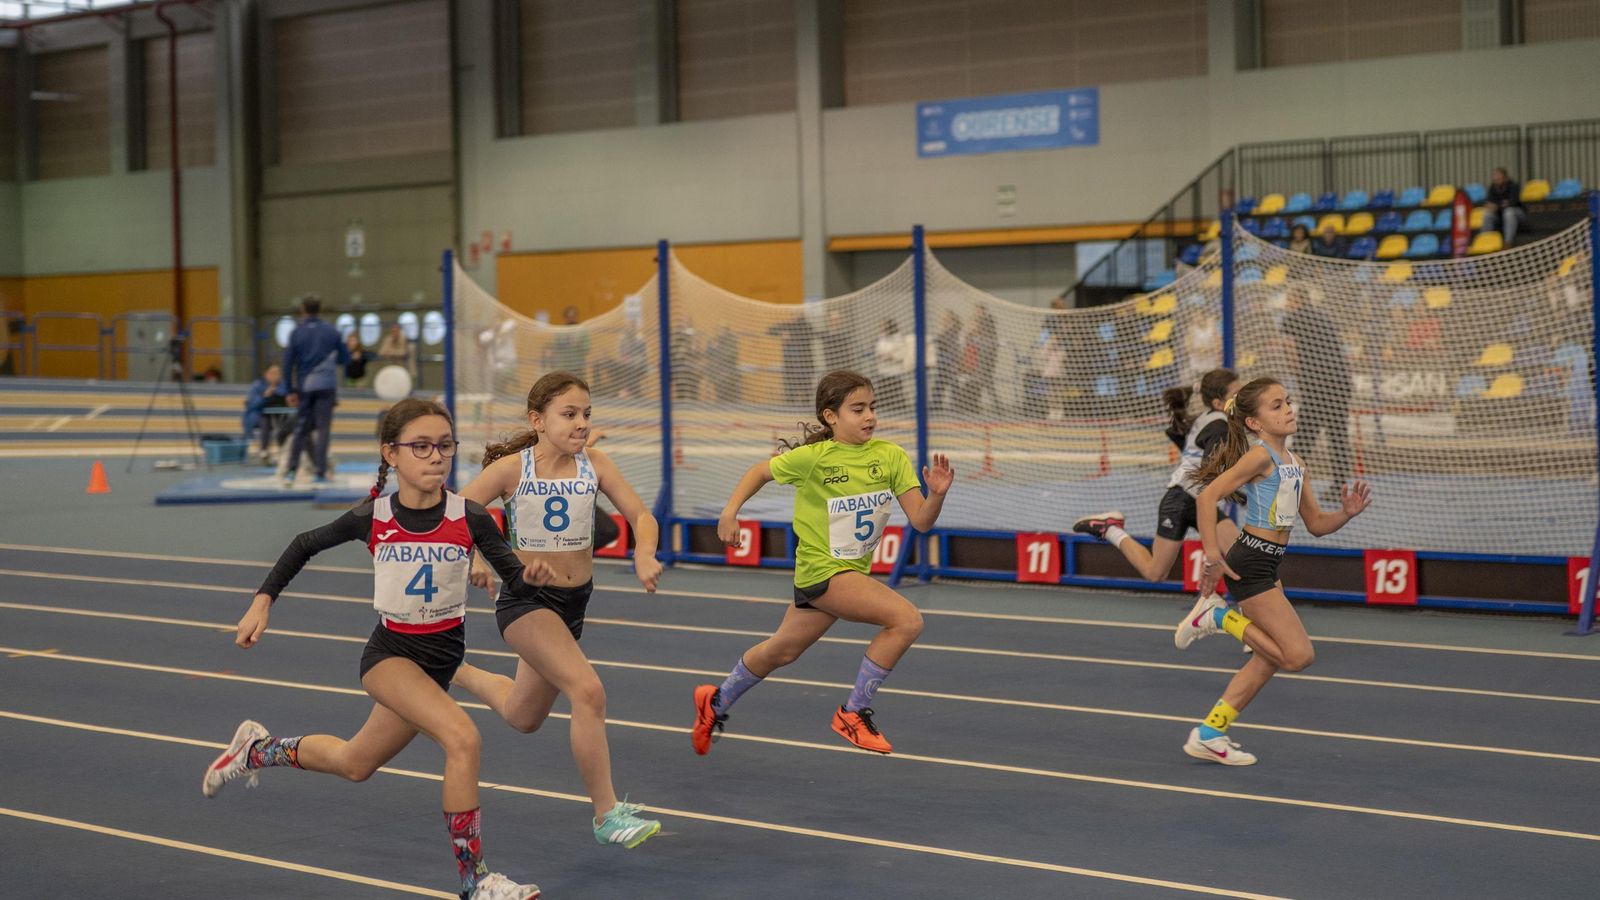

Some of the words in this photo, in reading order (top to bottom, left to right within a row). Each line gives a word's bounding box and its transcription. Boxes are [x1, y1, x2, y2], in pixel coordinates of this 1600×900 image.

[823, 475, 849, 485] PRO
[1294, 479, 1300, 507] 1
[543, 496, 570, 532] 8
[854, 509, 874, 541] 5
[734, 528, 752, 557] 9
[1026, 541, 1051, 573] 11
[1242, 535, 1274, 555] NIKE
[405, 564, 438, 603] 4
[1372, 559, 1408, 594] 13
